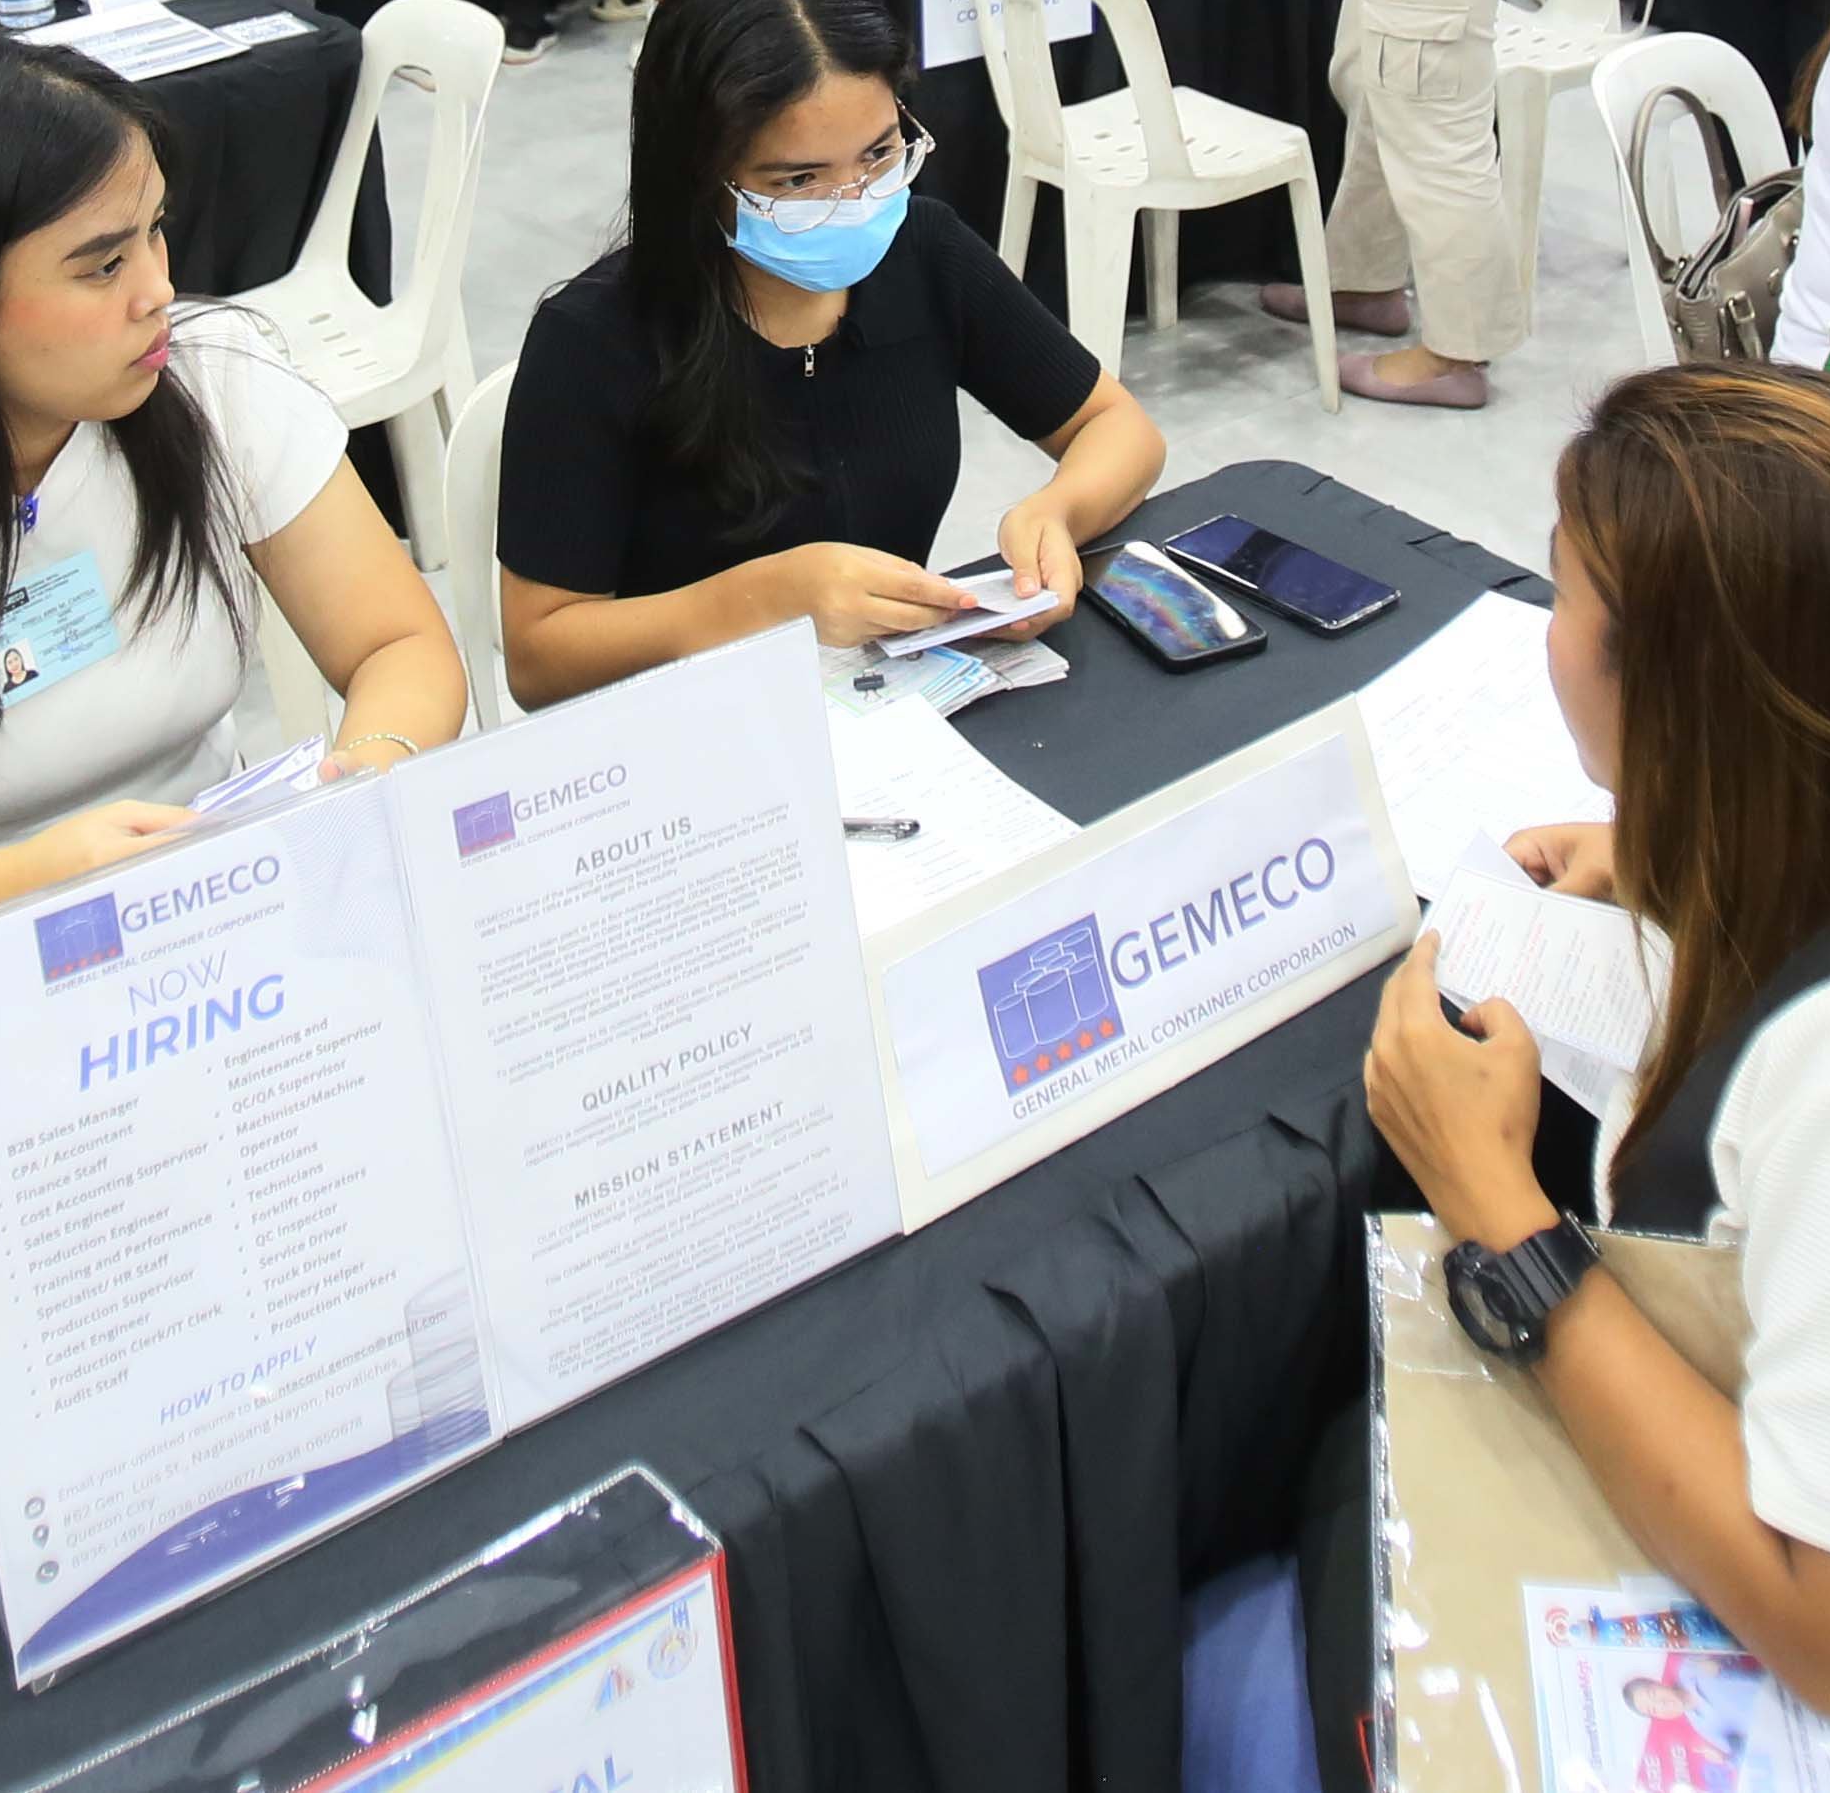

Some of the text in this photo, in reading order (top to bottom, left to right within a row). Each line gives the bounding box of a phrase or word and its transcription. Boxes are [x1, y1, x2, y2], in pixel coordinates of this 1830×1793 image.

[512, 763, 627, 822] GEMECO
[574, 815, 691, 876] ABOUT US
[119, 855, 280, 932] GEMECO
[1109, 837, 1335, 988] GEMECO
[44, 901, 285, 997] GENERAL METAL CONTAINER CORPORATION
[127, 948, 227, 1016] NOW
[79, 973, 284, 1091] HIRING
[222, 1016, 328, 1069] Engineering and
[1011, 921, 1357, 1120] GENERAL METAL CONTAINER CORPORATION
[227, 1020, 382, 1091] Maintenance Supervisor
[276, 1058, 346, 1095] Supervisor
[581, 1022, 752, 1111] QUALITY POLICY
[37, 1122, 75, 1145] Sales
[77, 1096, 139, 1129] Manager
[239, 1125, 299, 1158] Operator
[10, 1159, 39, 1180] CPA
[52, 1123, 133, 1165] Accountant
[15, 1155, 108, 1204] Finance Staff
[242, 1141, 318, 1180] Electricians
[573, 1100, 783, 1210] MISSION STATEMENT
[19, 1141, 208, 1226] Cost Accounting Supervisor
[246, 1162, 323, 1202] Technicians
[301, 1166, 366, 1202] Operators
[23, 1200, 125, 1251] Sales Engineer
[28, 1205, 170, 1274] Production Engineer
[258, 1221, 348, 1269] Service Driver
[276, 1202, 338, 1237] Inspector
[32, 1213, 212, 1296] Training and Performance
[112, 1269, 132, 1286] HR
[135, 1252, 168, 1278] Staff
[262, 1247, 342, 1291] Truck Driver
[40, 1268, 194, 1343] Production Supervisor
[266, 1261, 364, 1314] Delivery Helper
[270, 1268, 396, 1335] Production Workers
[44, 1311, 151, 1366] Cadet Engineer
[49, 1348, 127, 1389] Production
[186, 1303, 221, 1327] Clerk
[53, 1366, 129, 1413] Audit Staff
[159, 1334, 317, 1425] HOW TO APPLY
